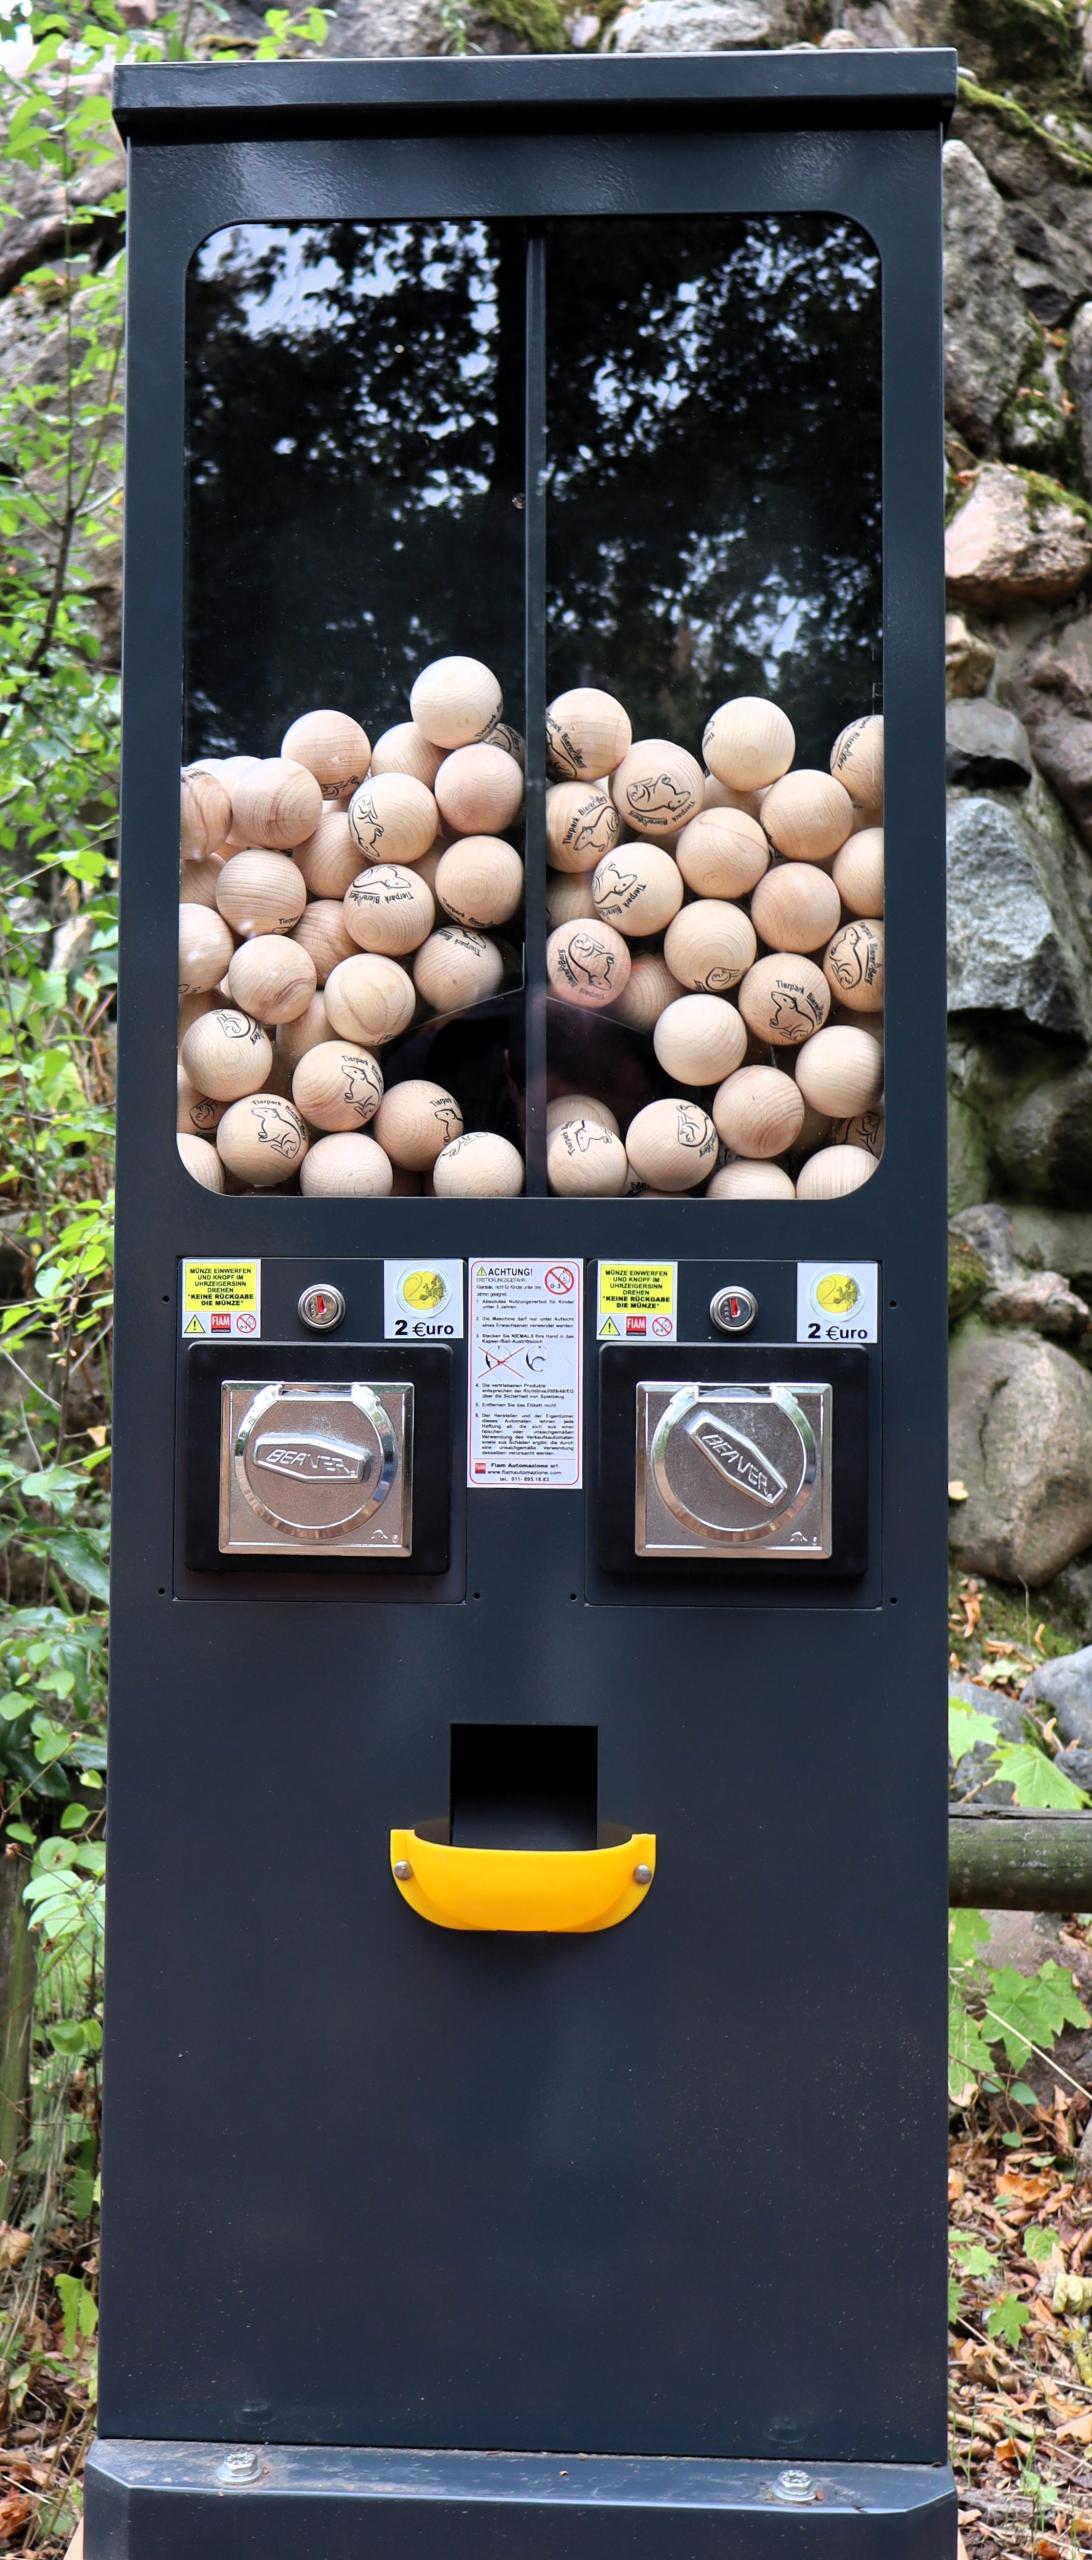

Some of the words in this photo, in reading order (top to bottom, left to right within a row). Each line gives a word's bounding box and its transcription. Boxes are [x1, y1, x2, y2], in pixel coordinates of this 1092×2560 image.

[562, 818, 579, 844] Tierpark
[384, 892, 414, 903] Tierpark
[623, 884, 647, 908] Tierpark
[776, 980, 804, 994] Tierpark
[341, 1056, 368, 1066] Tierpark
[488, 1268, 532, 1276] ACHTUNG!
[213, 1316, 229, 1326] FIAM
[395, 1320, 408, 1335] 2
[412, 1322, 454, 1336] €uro
[628, 1319, 645, 1328] FIAM
[808, 1323, 821, 1338] 2
[825, 1326, 867, 1340] €uro
[265, 1449, 351, 1475] BEAVER
[702, 1434, 768, 1496] BEAVER
